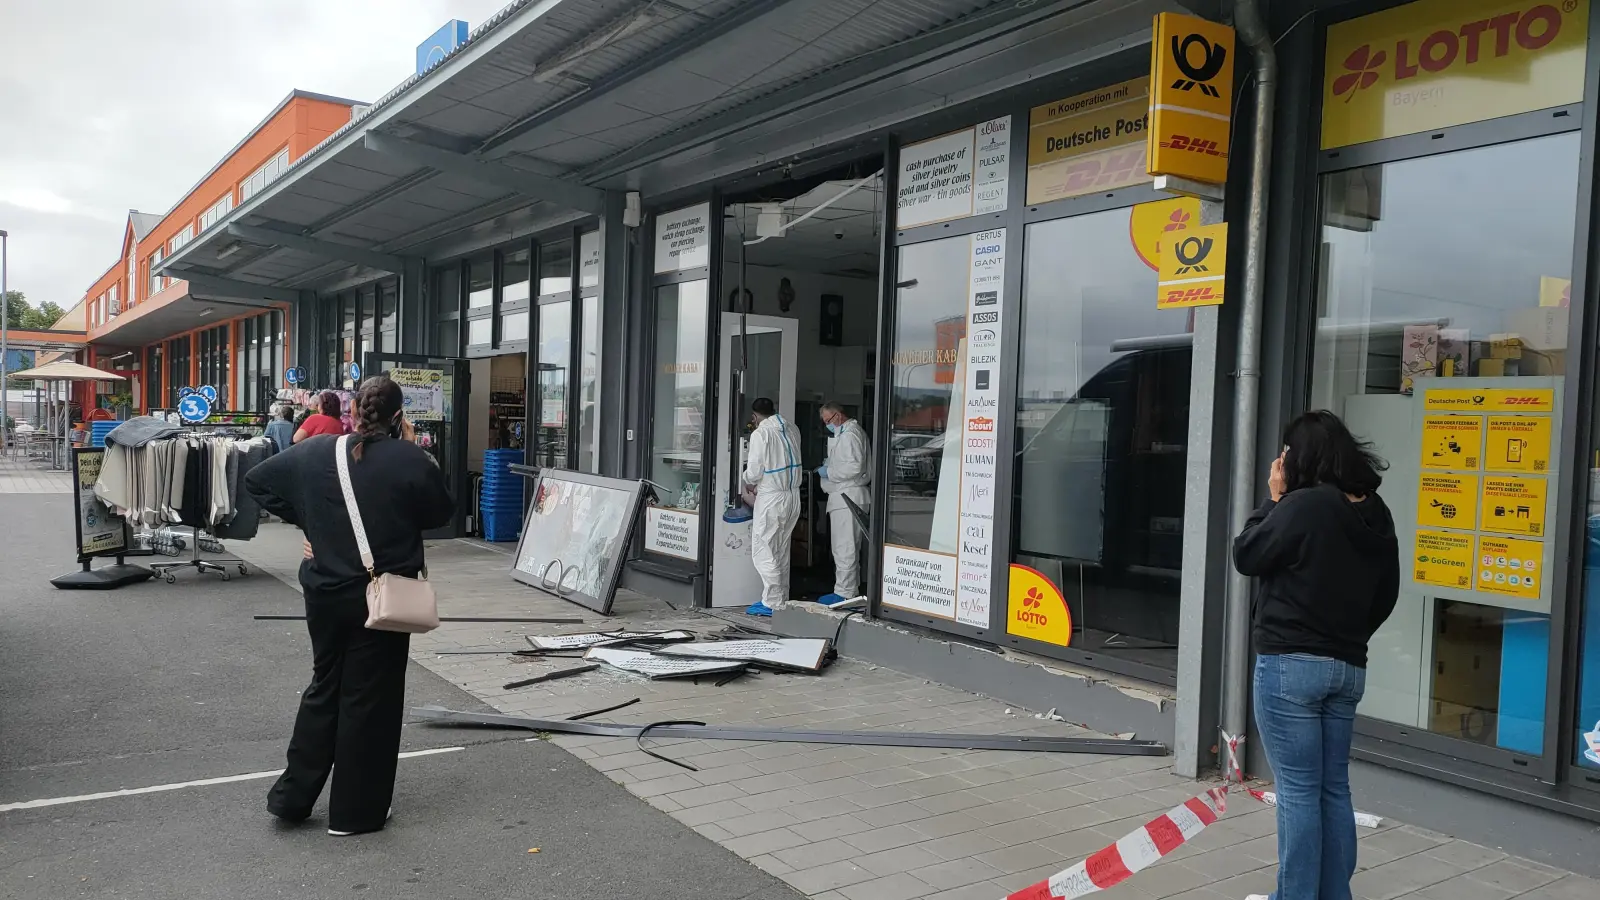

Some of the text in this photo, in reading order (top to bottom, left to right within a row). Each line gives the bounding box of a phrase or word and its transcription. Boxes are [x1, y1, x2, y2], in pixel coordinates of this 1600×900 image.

[1395, 4, 1562, 80] LOTTO
[1048, 87, 1128, 116] In Kooperation mit
[1393, 86, 1444, 106] Bayern
[1047, 115, 1148, 153] Deutsche Post
[1170, 134, 1221, 157] DHL
[906, 147, 966, 172] cash purchase of
[979, 155, 1005, 168] PULSAR
[912, 163, 958, 182] silver jewelry
[1064, 150, 1148, 192] DH
[900, 185, 914, 198] gold
[916, 183, 929, 192] and
[930, 178, 950, 190] silver
[952, 173, 970, 184] coins
[978, 188, 1004, 200] REGENT
[898, 197, 918, 208] silver
[938, 189, 948, 200] tin
[949, 184, 971, 198] goods
[976, 230, 1002, 241] CERTUS
[976, 245, 1000, 255] CASIO
[974, 258, 1003, 267] GANT
[1166, 286, 1215, 304] DHL
[974, 313, 997, 322] ASSOS
[971, 355, 996, 364] BILEZIK
[896, 556, 942, 571] Barankauf von
[1431, 556, 1465, 567] GoGreen
[897, 566, 942, 582] Silberschmuck
[884, 575, 955, 596] Gold und Silbermünzen
[886, 586, 904, 596] Silber
[916, 592, 951, 607] Zinnwaren
[1017, 610, 1047, 626] LOTTO
